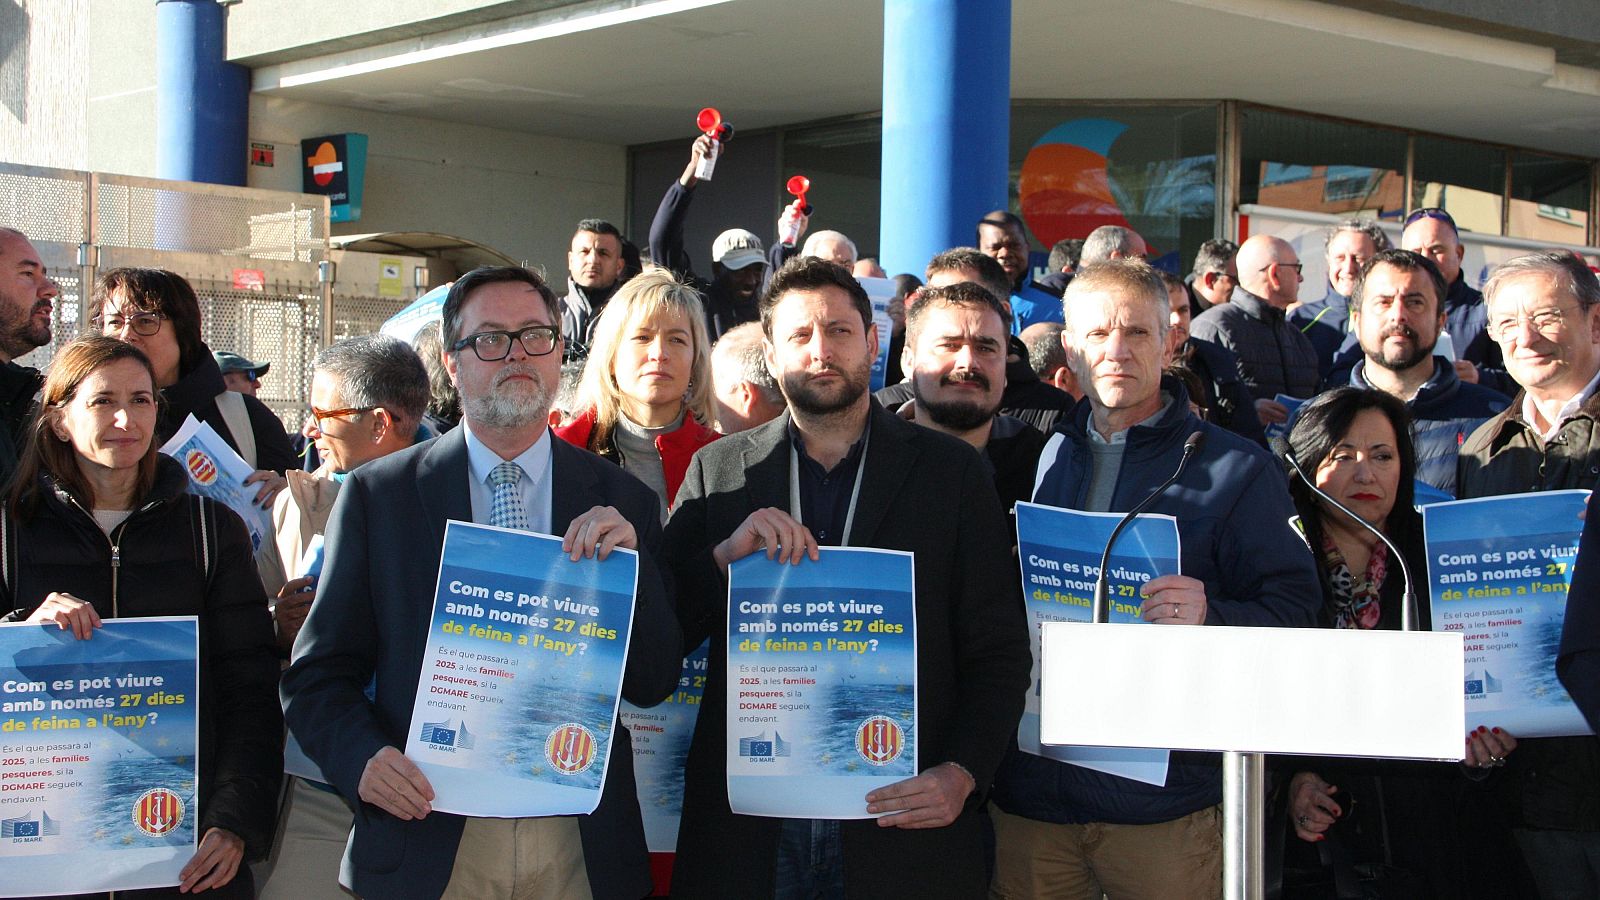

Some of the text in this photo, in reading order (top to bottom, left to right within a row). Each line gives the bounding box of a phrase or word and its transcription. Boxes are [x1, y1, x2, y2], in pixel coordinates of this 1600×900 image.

[1438, 553, 1477, 567] Com
[1481, 552, 1502, 564] es
[1506, 547, 1537, 564] pot
[1028, 554, 1151, 583] Com es po viure
[1439, 569, 1478, 584] amb
[1482, 564, 1542, 581] només
[1545, 562, 1568, 576] 27
[1030, 573, 1062, 587] amb
[1065, 578, 1115, 595] noms
[1118, 584, 1135, 597] 27
[1441, 588, 1463, 601] de
[1467, 585, 1512, 599] feina
[1516, 585, 1527, 595] a
[449, 580, 600, 617] Com es pot viure
[1032, 588, 1051, 601] de
[1054, 591, 1091, 608] feina
[739, 600, 884, 617] Com es pot viure
[1463, 611, 1480, 619] que
[445, 601, 618, 640] amb només 27 dies
[739, 618, 904, 634] amb només 27 dies
[1474, 621, 1487, 629] les
[442, 620, 588, 657] de feina a l'any?
[738, 638, 879, 654] de feina a l'any?
[458, 651, 475, 659] que
[1486, 642, 1519, 652] segueix
[435, 659, 457, 671] 2025,
[465, 664, 478, 673] les
[751, 665, 759, 673] el
[760, 666, 777, 674] que
[3, 673, 164, 694] Com es pot viure
[432, 673, 479, 688] pesqueres,
[489, 681, 497, 690] la
[739, 677, 762, 686] 2025,
[2, 690, 185, 713] amb només 27 dies
[430, 685, 504, 705] DGMARE segueix
[739, 690, 785, 699] pesqueres,
[795, 690, 802, 698] la
[427, 699, 468, 712] endavant.
[739, 702, 810, 711] DGMARE segueix
[1, 711, 158, 732] de feina a l'any?
[15, 745, 24, 753] el
[26, 745, 45, 753] que
[438, 745, 457, 753] MARE
[1, 758, 27, 766] 2025,
[1, 769, 55, 780] pesqueres,
[1, 780, 84, 791] DGMARE segueix
